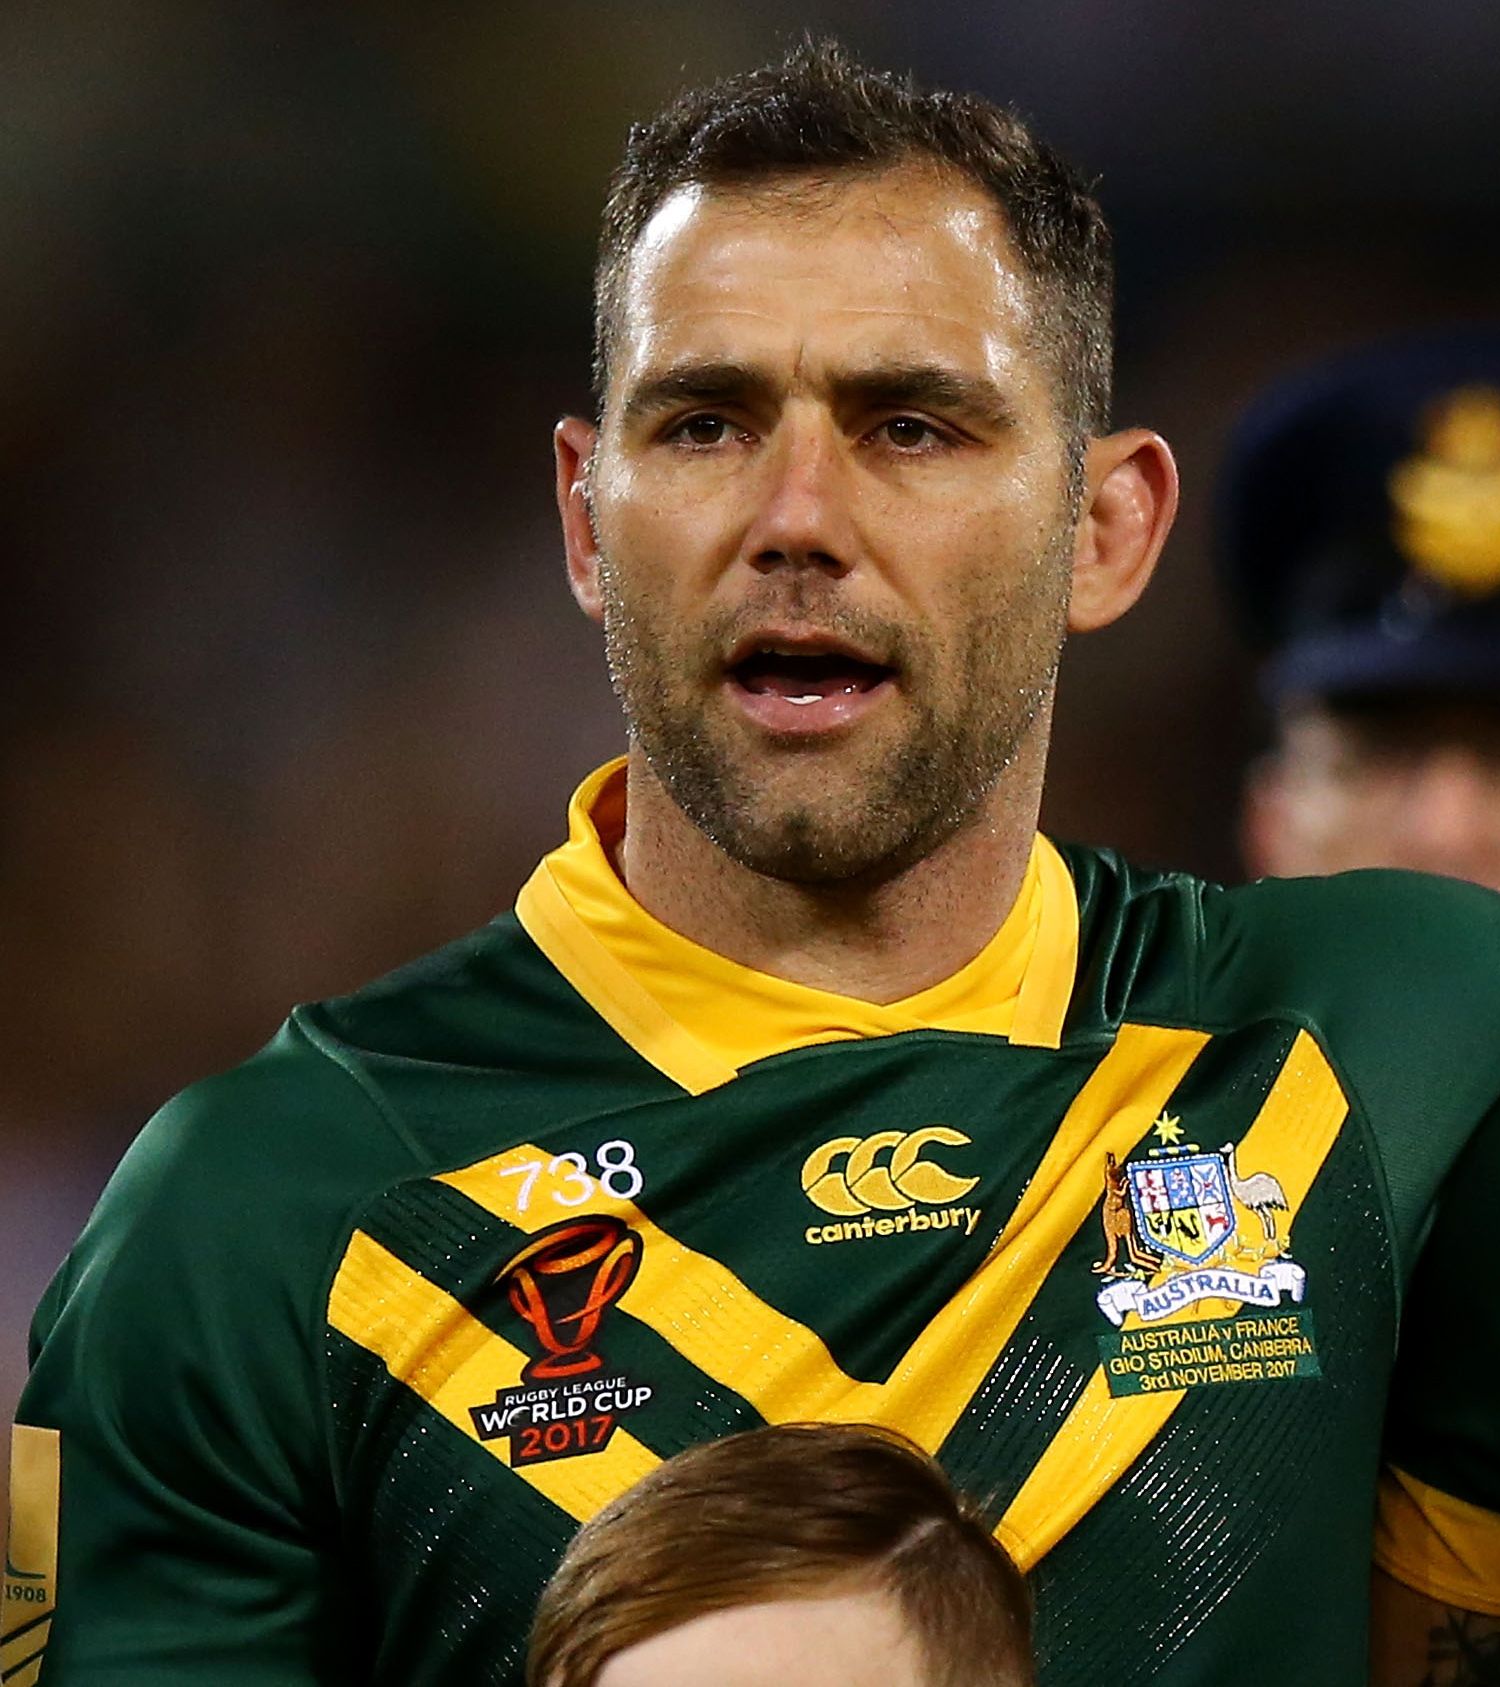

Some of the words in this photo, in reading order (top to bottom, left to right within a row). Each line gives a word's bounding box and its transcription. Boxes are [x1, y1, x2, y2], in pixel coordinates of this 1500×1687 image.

[499, 1139, 644, 1212] 738
[804, 1207, 982, 1245] canterbury
[1142, 1273, 1274, 1316] AUSTRALIA
[1121, 1323, 1221, 1353] AUSTRALIA
[1222, 1327, 1232, 1341] v
[1236, 1316, 1299, 1339] FRANCE
[1109, 1357, 1146, 1375] GIO
[1149, 1344, 1227, 1370] STADIUM,
[1230, 1337, 1312, 1361] CANBERRA
[504, 1387, 559, 1407] RUGBY
[563, 1376, 627, 1397] LEAGUE
[1140, 1373, 1170, 1391] 3rd
[1173, 1363, 1264, 1388] NOVEMBER
[1267, 1360, 1296, 1378] 2017
[480, 1397, 587, 1432] WORLD
[594, 1386, 652, 1412] CUP
[520, 1414, 615, 1457] 2017
[4, 1583, 47, 1603] 1908
